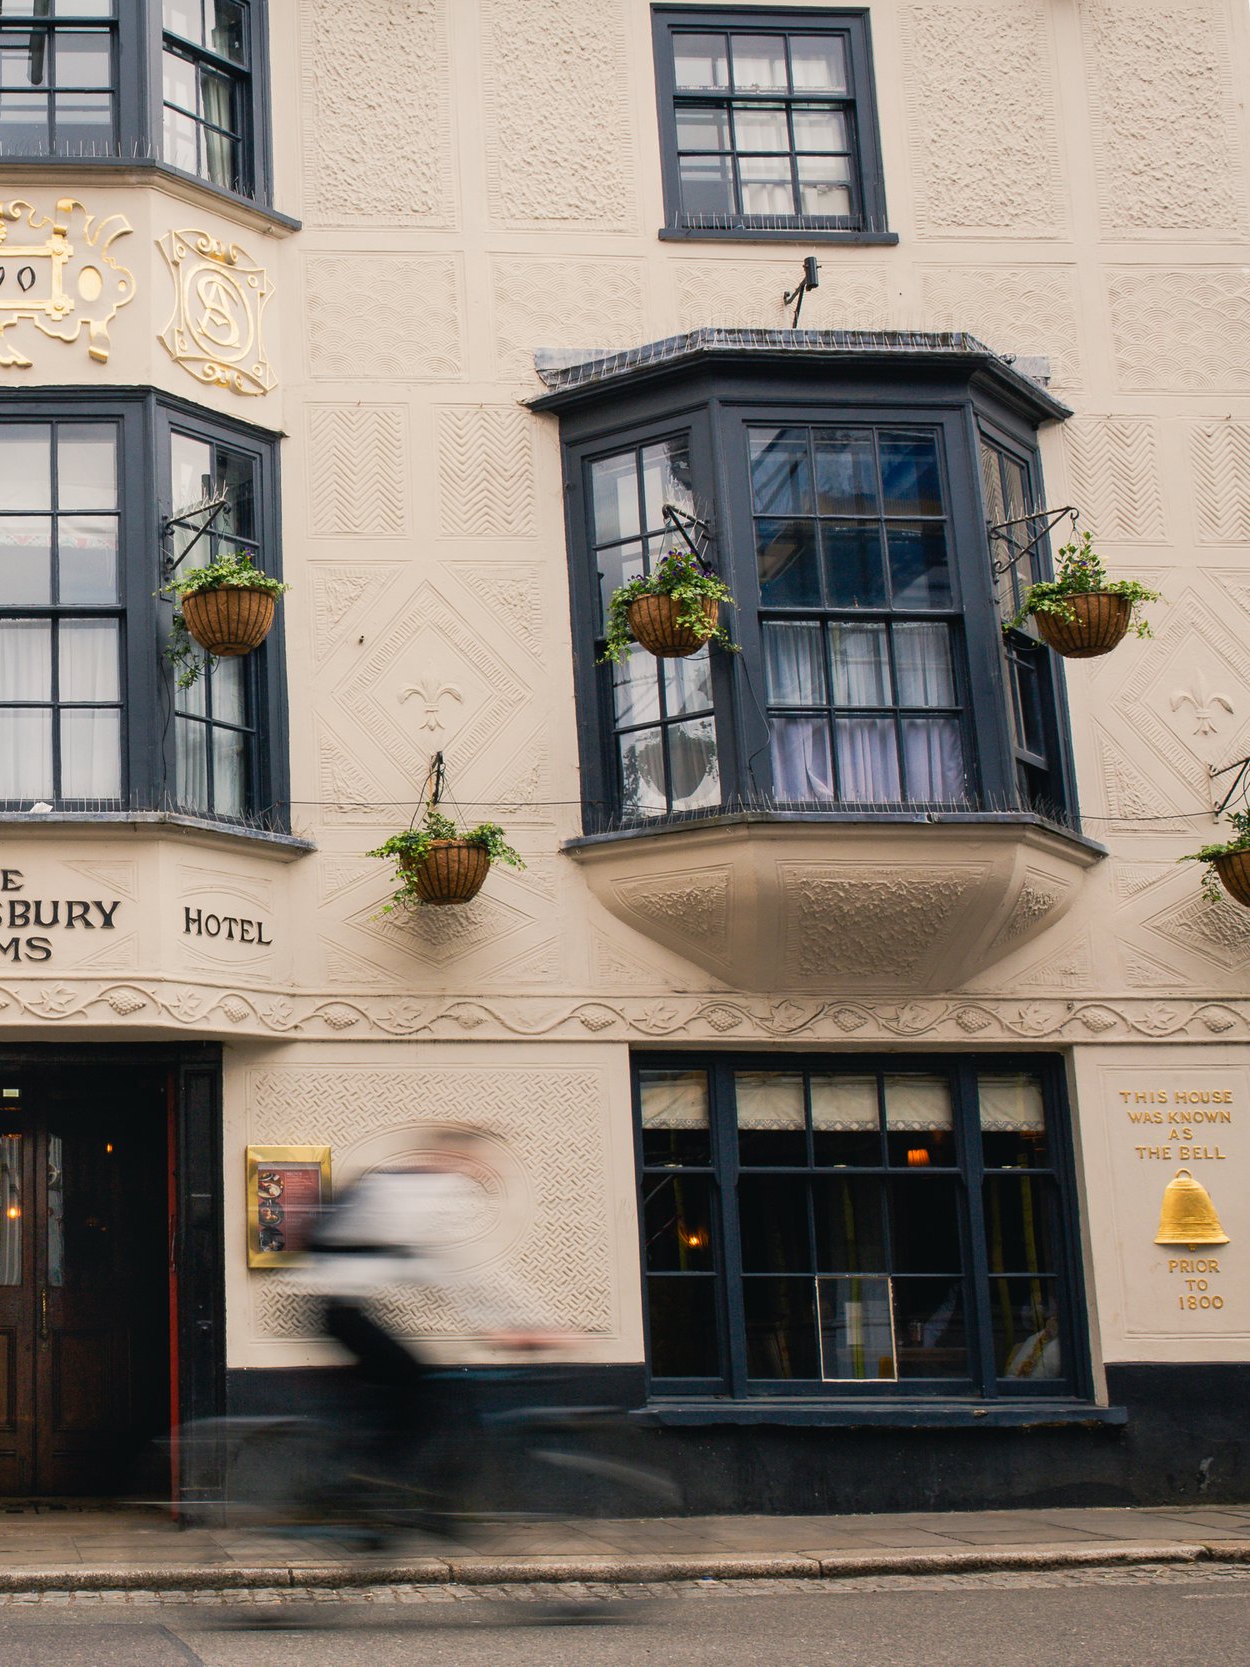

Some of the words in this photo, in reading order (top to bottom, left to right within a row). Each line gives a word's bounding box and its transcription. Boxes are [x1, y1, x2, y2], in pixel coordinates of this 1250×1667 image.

[183, 905, 273, 946] HOTEL
[1119, 1090, 1168, 1104] THIS
[1174, 1089, 1233, 1104] HOUSE
[1127, 1111, 1163, 1124] WAS
[1168, 1110, 1231, 1124] KNOWN
[1168, 1127, 1193, 1141] AS
[1135, 1146, 1172, 1160] THE
[1179, 1146, 1226, 1161] BELL
[1168, 1259, 1220, 1274] PRIOR
[1185, 1279, 1208, 1292] TO
[1178, 1295, 1224, 1310] 1800
